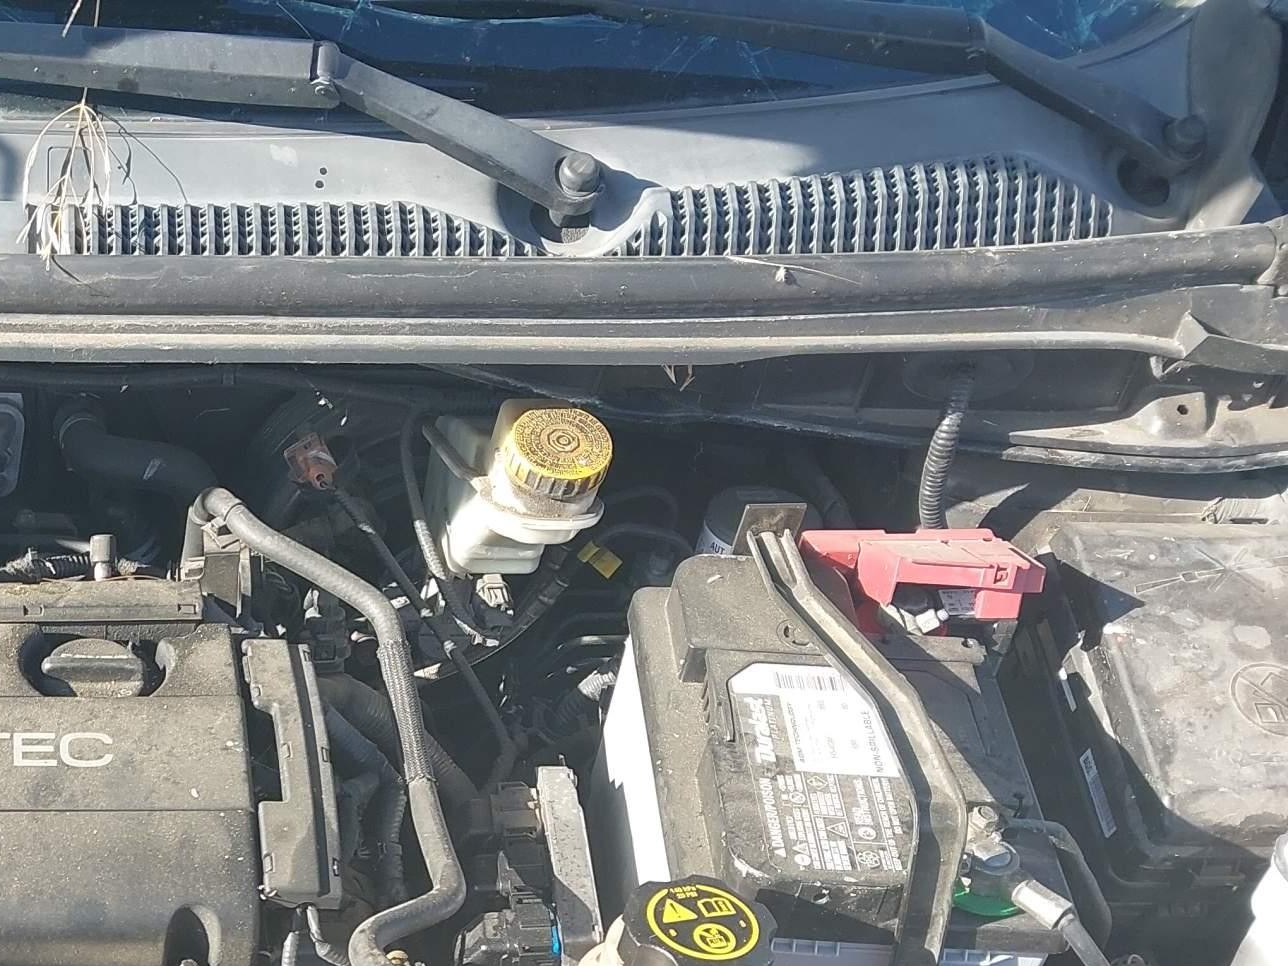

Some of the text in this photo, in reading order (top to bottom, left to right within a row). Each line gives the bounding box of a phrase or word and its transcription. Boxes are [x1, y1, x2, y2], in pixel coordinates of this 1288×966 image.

[746, 697, 776, 763] Duralast
[764, 698, 779, 738] PLATINUM
[861, 711, 883, 772] NON-SPILLABLE
[760, 778, 782, 847] DANGER/POISON
